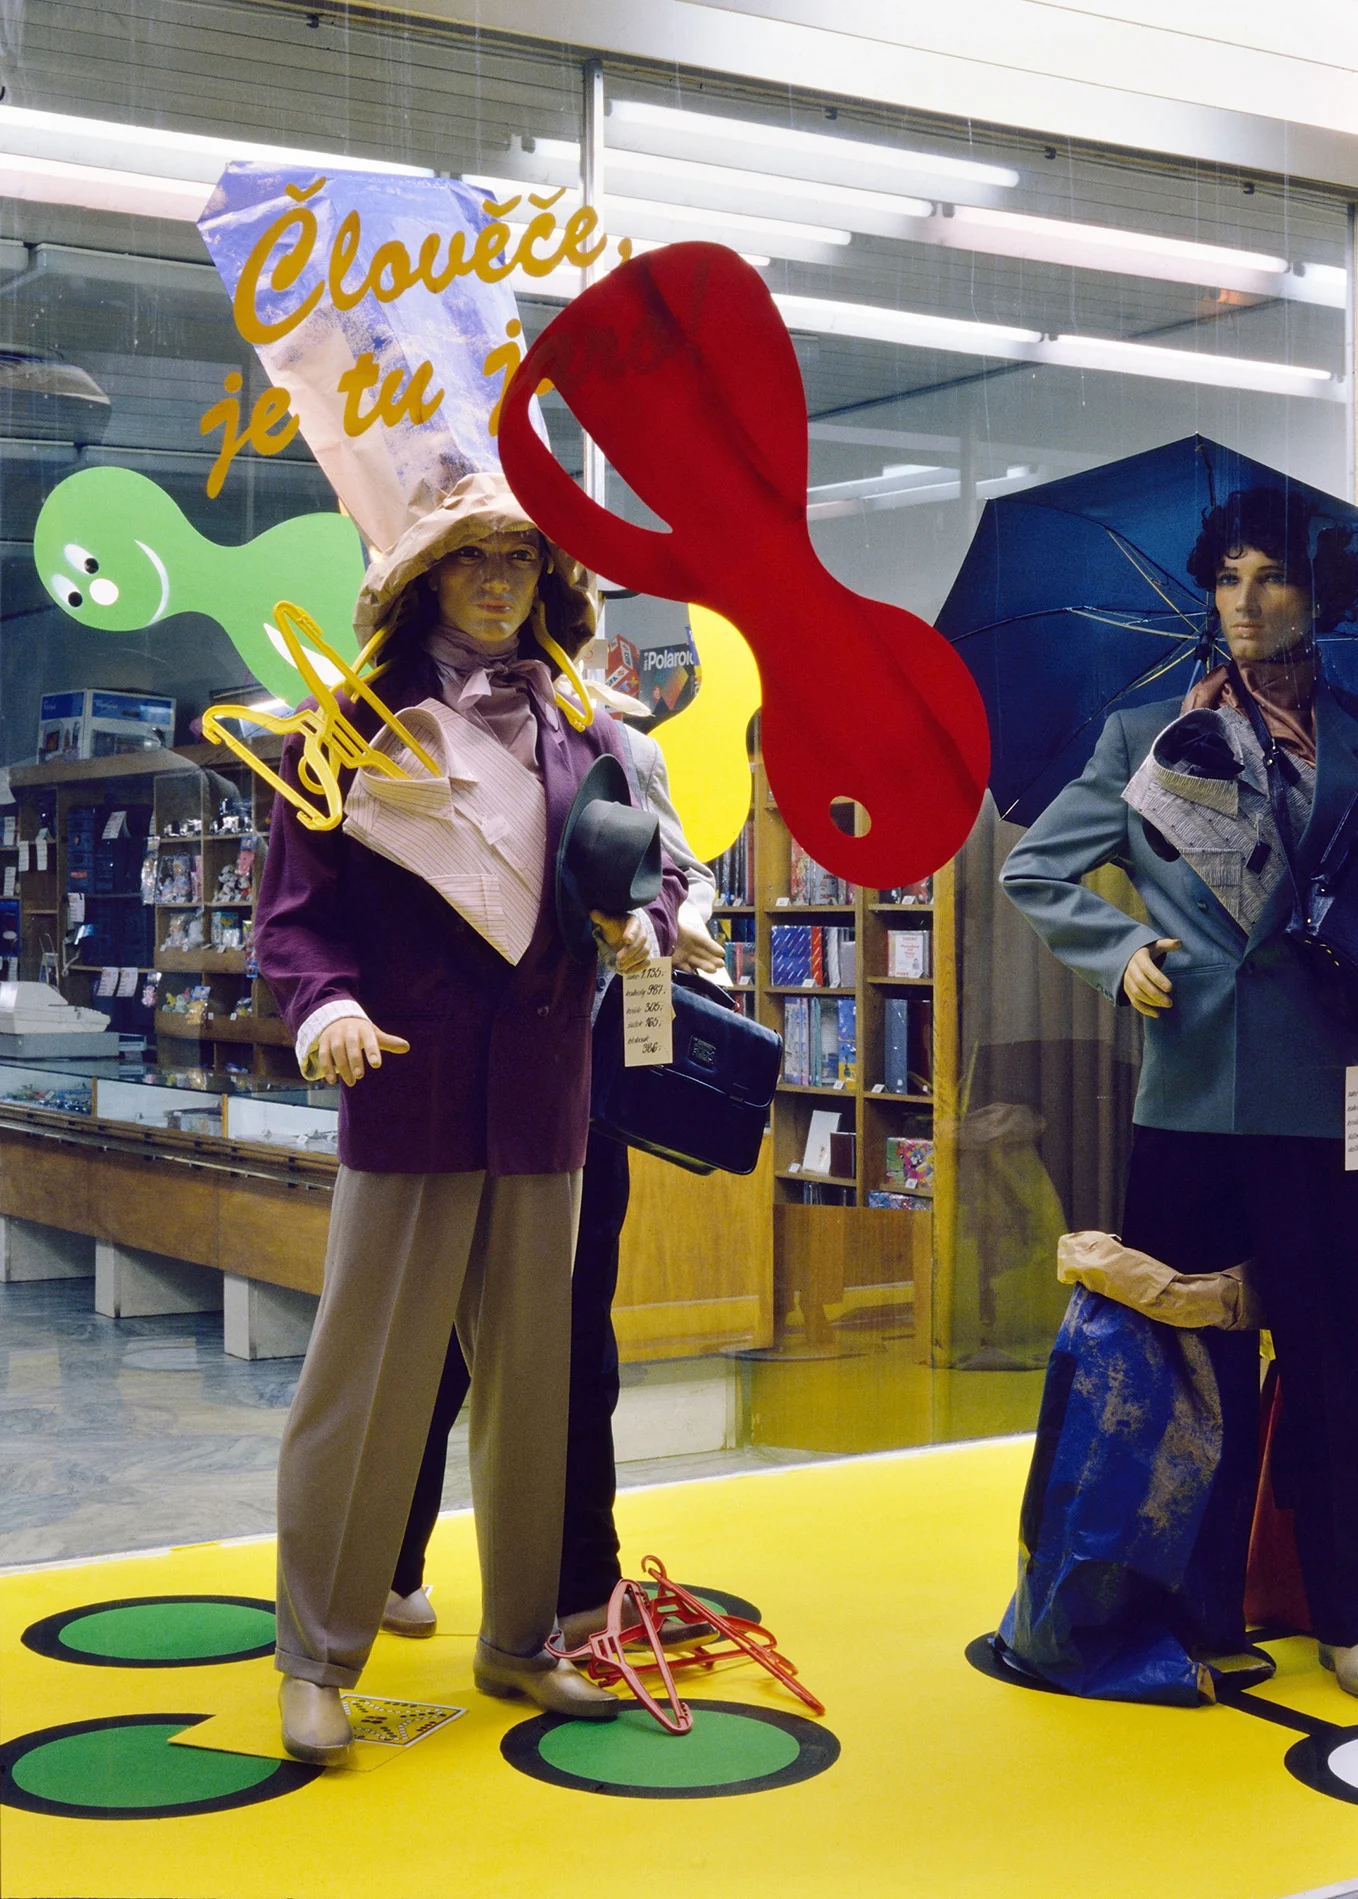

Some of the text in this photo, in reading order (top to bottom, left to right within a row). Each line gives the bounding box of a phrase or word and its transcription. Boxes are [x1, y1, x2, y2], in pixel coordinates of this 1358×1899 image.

[233, 176, 633, 345] Člověče,
[200, 372, 300, 500] je
[337, 352, 445, 438] tu
